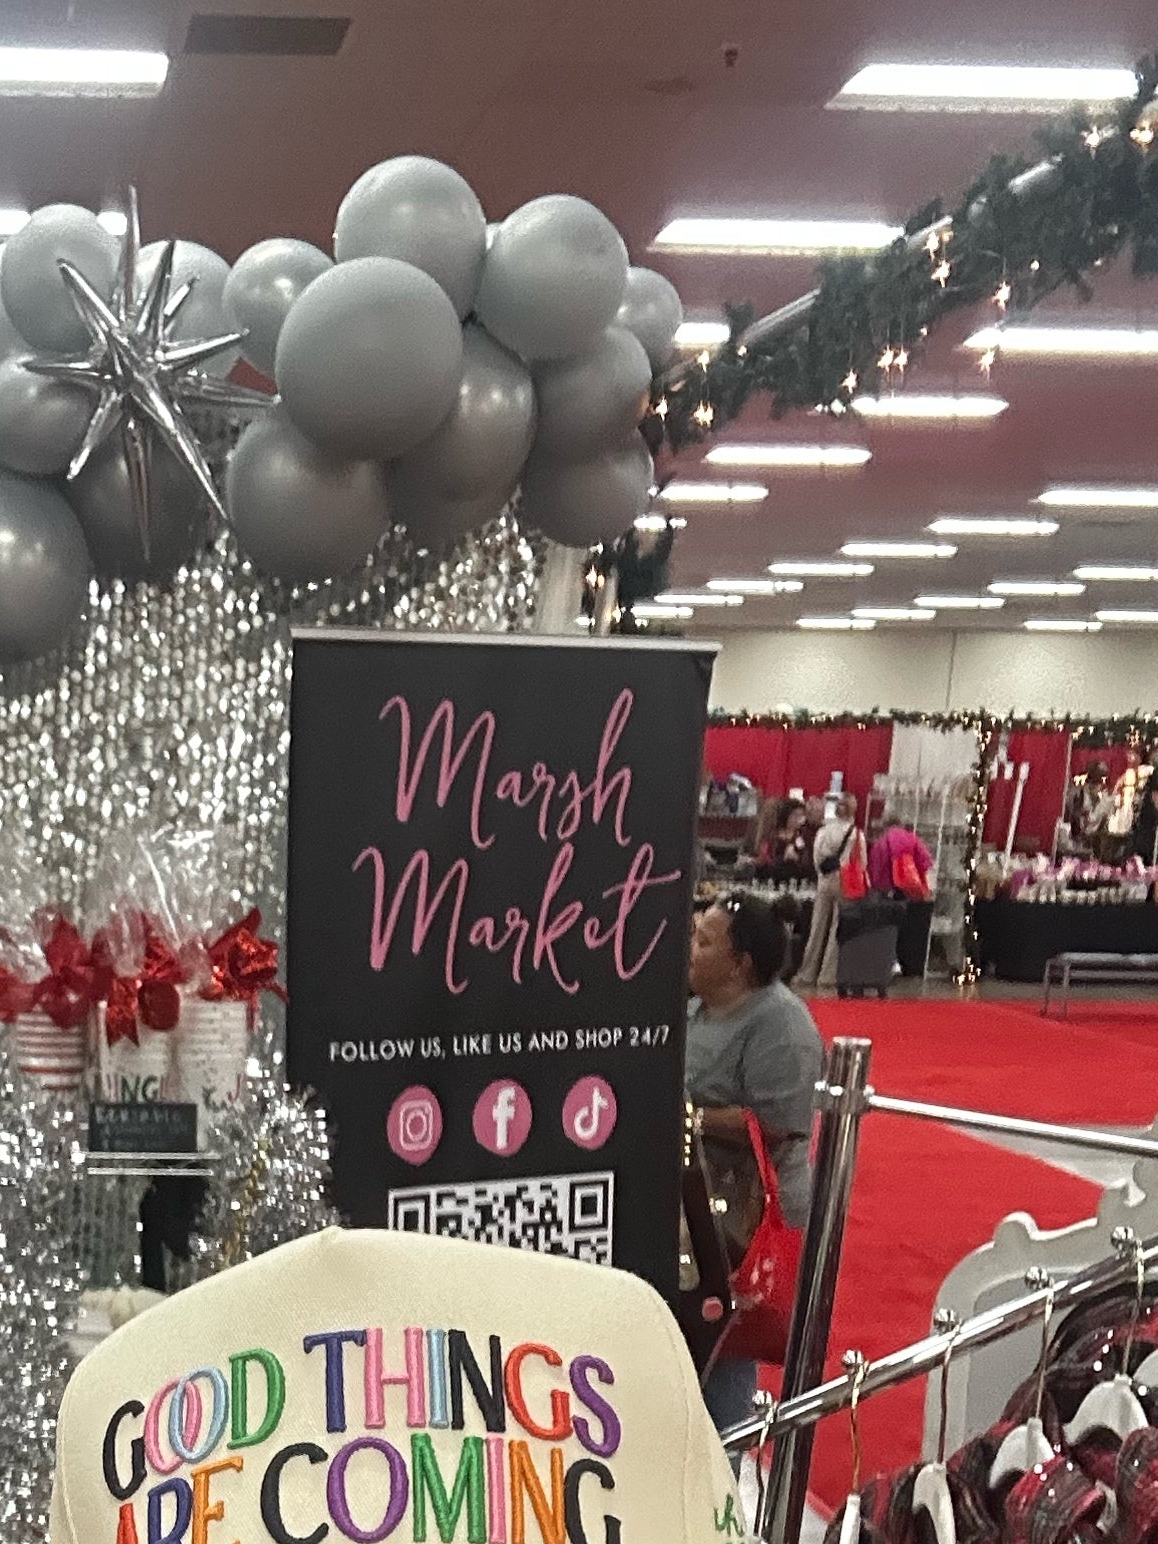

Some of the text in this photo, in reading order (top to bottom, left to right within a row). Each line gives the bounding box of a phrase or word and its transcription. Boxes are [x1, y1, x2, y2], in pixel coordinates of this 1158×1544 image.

[379, 687, 634, 850] Marsh
[352, 842, 681, 995] Market
[329, 1024, 670, 1063] FOLLOW US, LIKE US AND SHOP 24/7
[103, 1327, 622, 1500] GOOD THINGS
